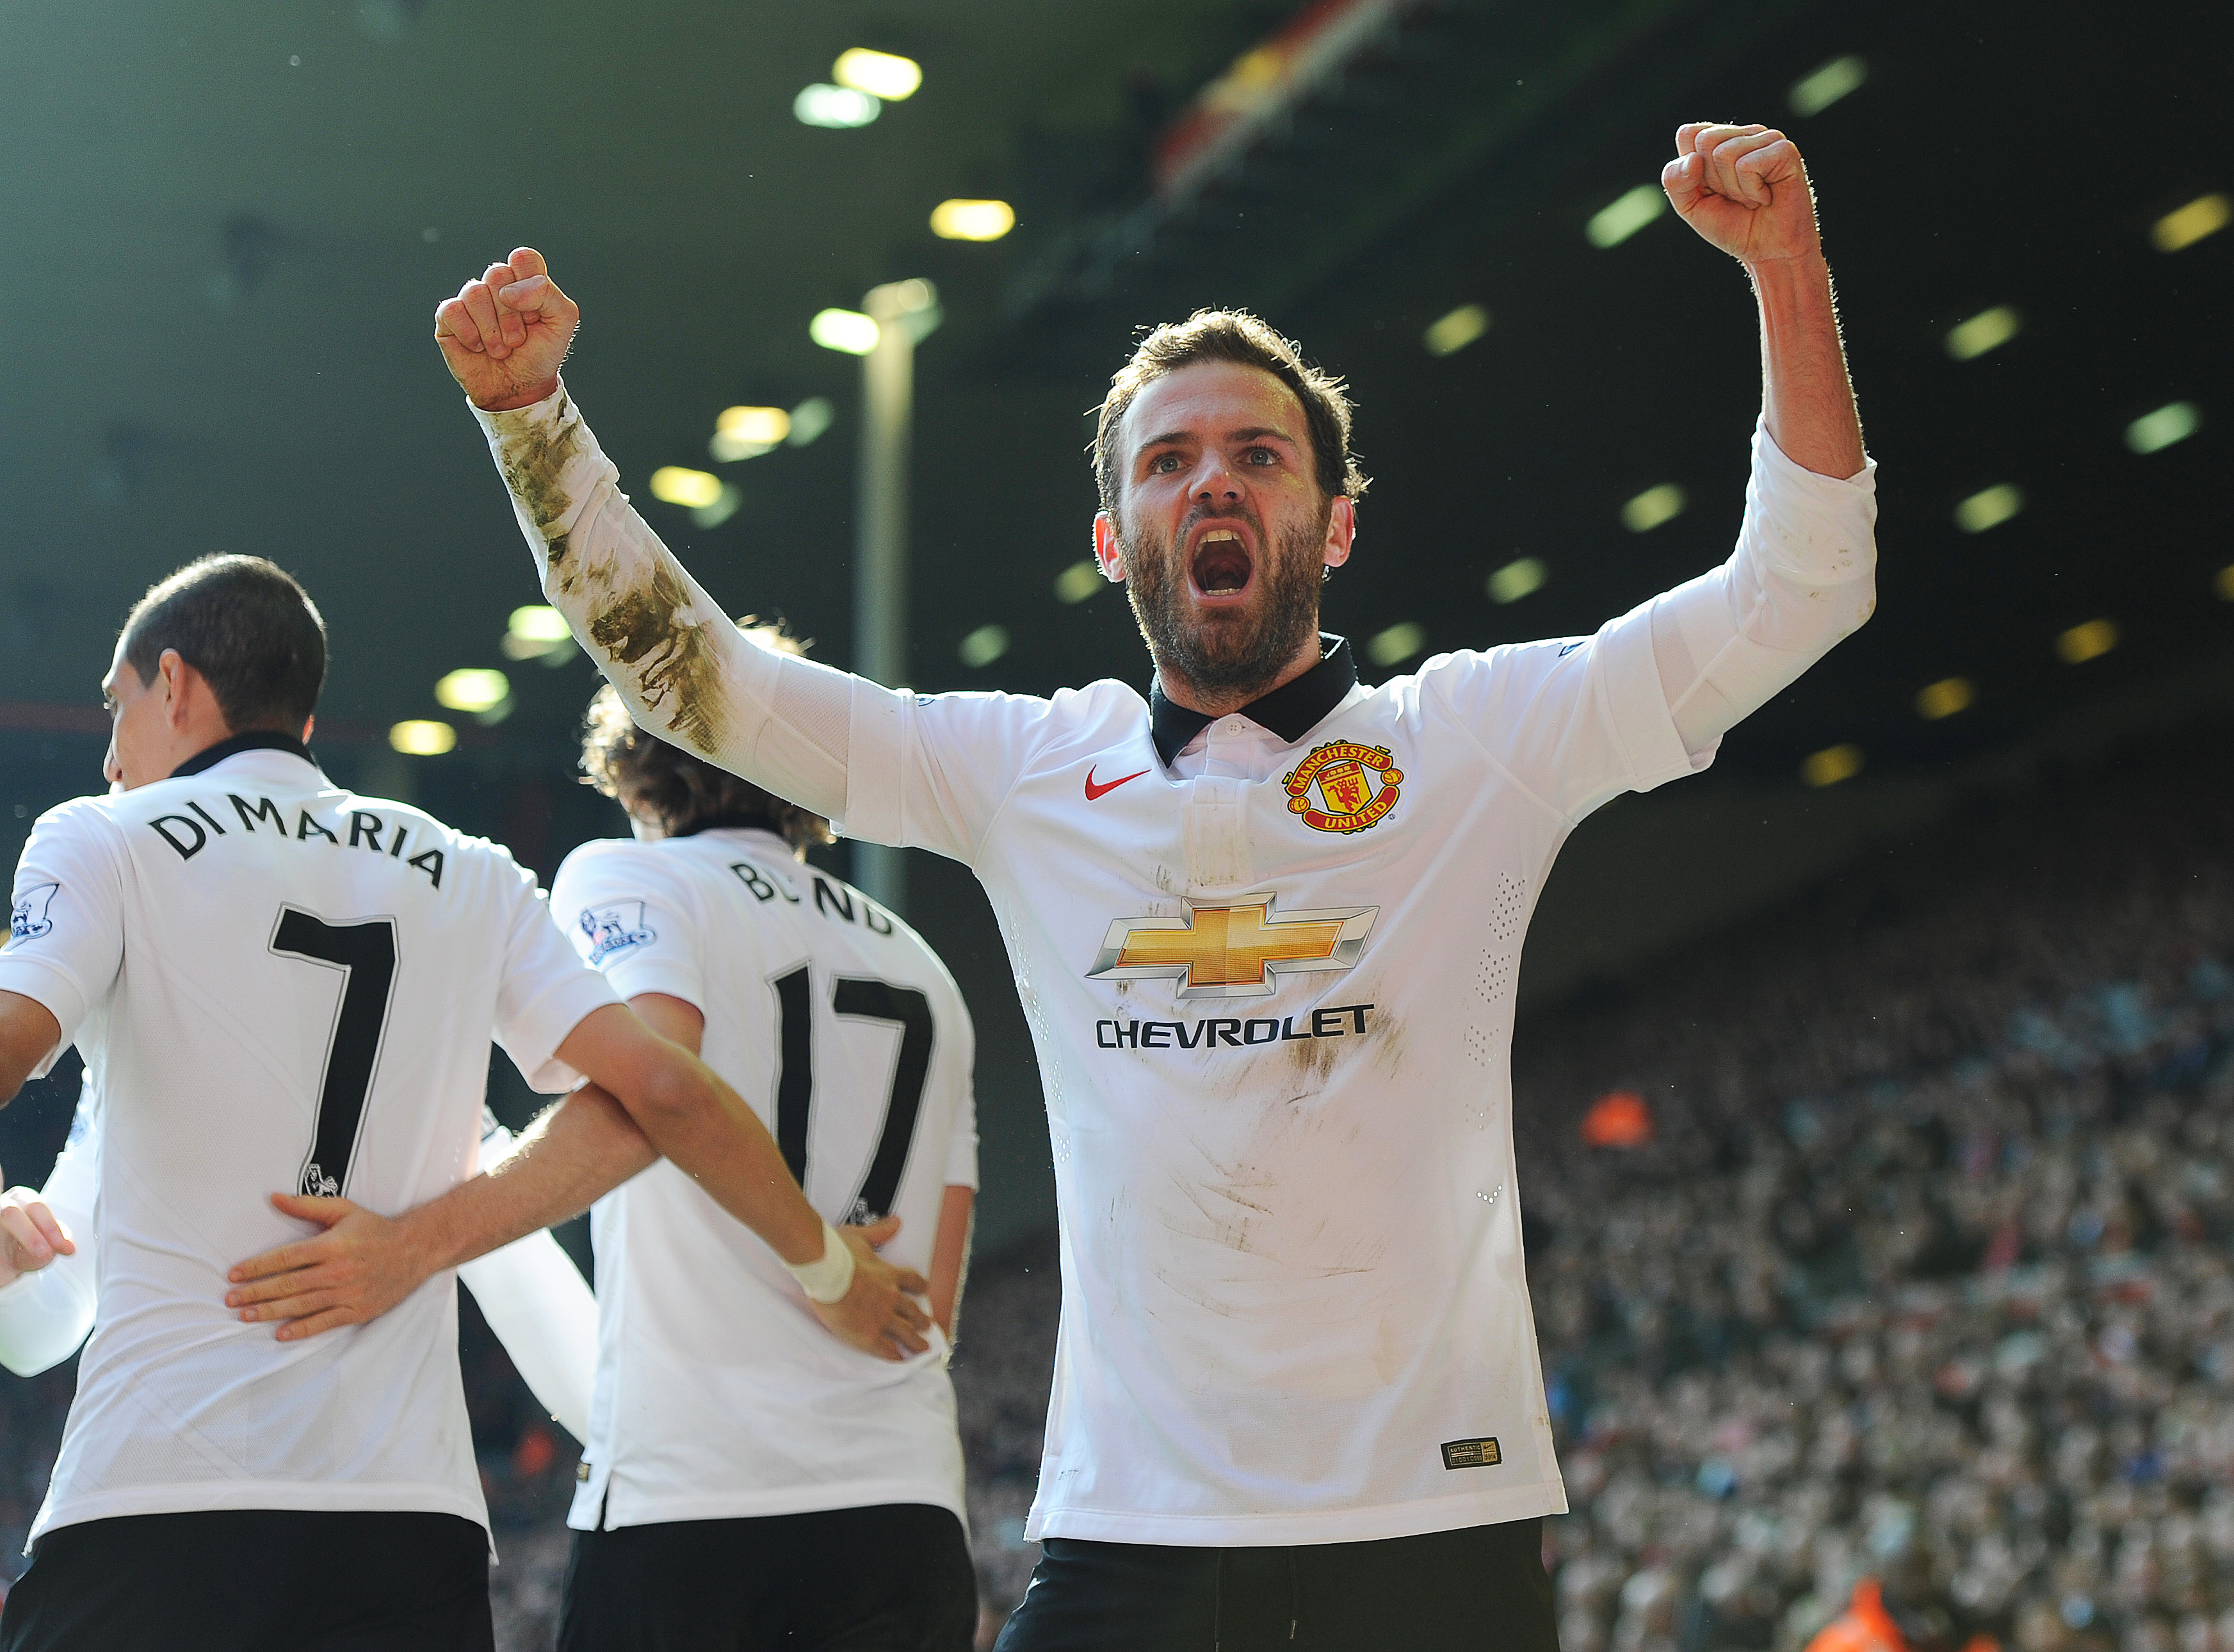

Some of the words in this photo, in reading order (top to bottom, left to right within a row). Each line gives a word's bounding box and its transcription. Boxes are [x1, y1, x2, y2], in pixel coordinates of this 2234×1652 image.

[1293, 746, 1384, 790] MANCHESTER
[148, 801, 226, 862] DI
[227, 794, 446, 890] MARIA
[1324, 801, 1388, 829] UNITED
[268, 901, 401, 1199] 7
[1096, 1003, 1375, 1049] CHEVROLET
[765, 958, 935, 1227] 17
